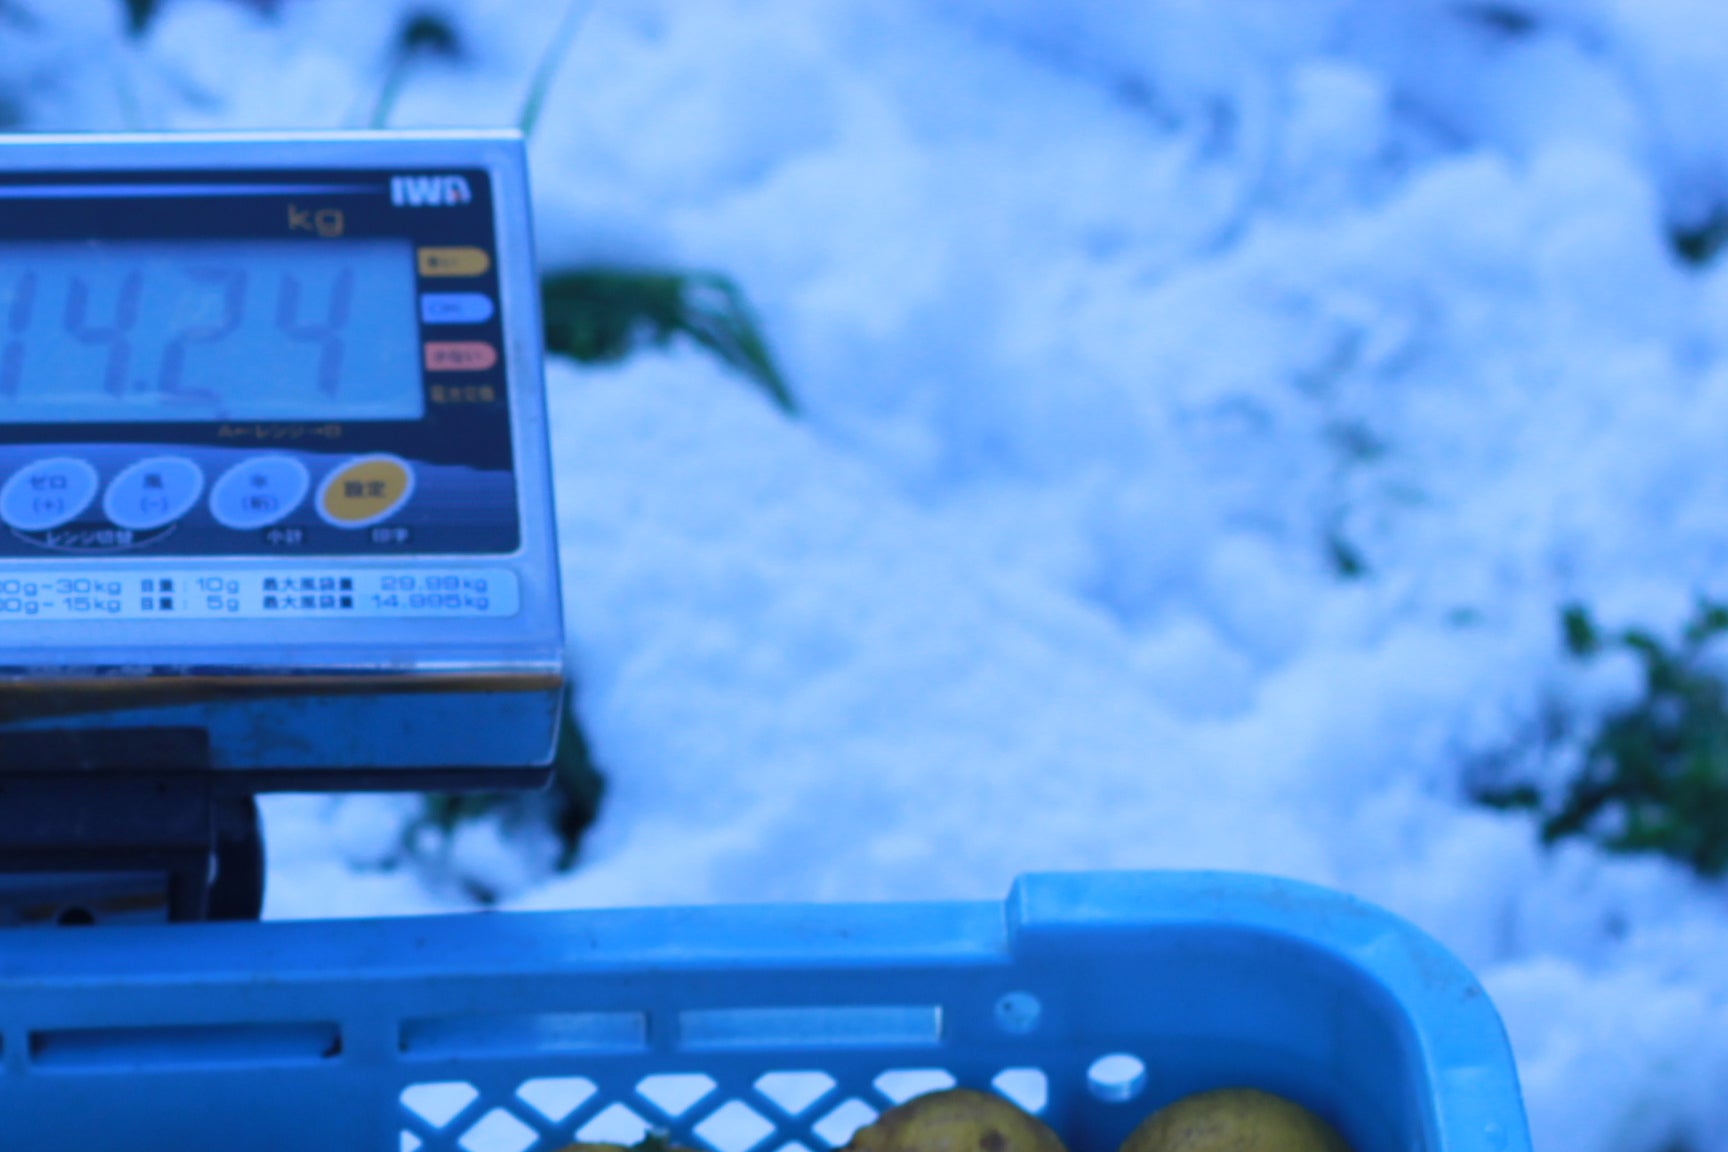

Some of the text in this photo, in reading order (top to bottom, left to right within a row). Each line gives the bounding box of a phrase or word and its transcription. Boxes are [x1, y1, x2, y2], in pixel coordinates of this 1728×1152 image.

[288, 204, 345, 237] kg
[198, 577, 240, 595] 10g
[207, 594, 240, 613] 5g
